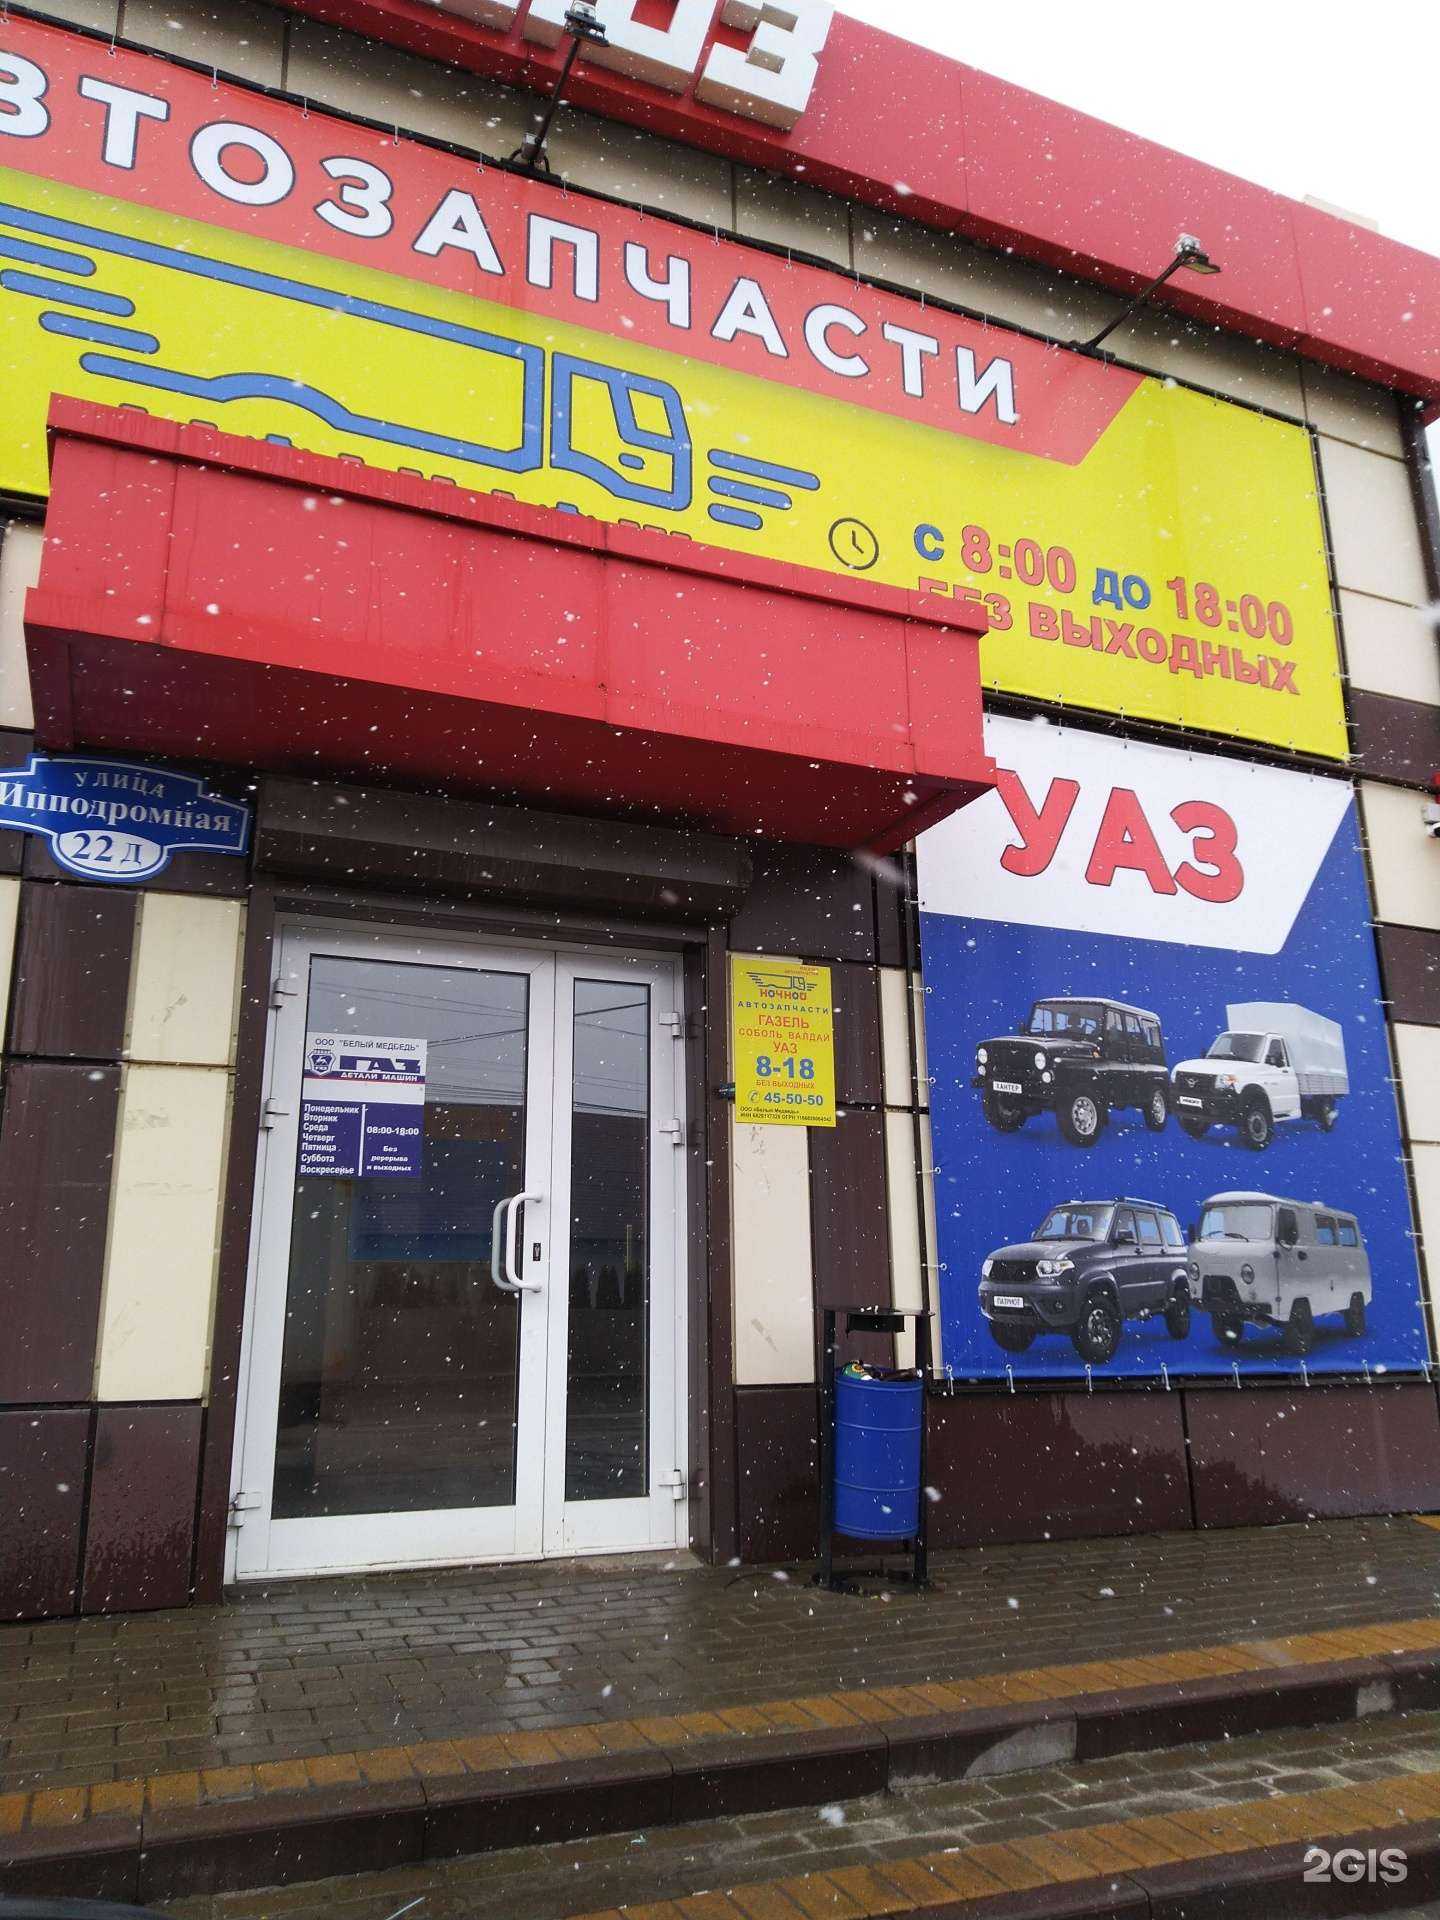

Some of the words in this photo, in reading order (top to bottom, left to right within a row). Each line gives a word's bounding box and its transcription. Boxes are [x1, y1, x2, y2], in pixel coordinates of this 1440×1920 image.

[960, 525, 1077, 593] 8:00
[1166, 576, 1294, 646] 18:00
[1028, 601, 1300, 695] ВЫХОДНЫХ
[0, 781, 232, 833] Ипподромная
[995, 767, 1245, 903] УАЗ
[737, 1000, 829, 1014] АВТОЗАПЧАСТИ
[758, 1014, 810, 1029] ГАЗЕЛЬ
[738, 1027, 783, 1039] СОБОЛЬ
[315, 1038, 335, 1046] ООО
[772, 1041, 798, 1054] УАЗ
[339, 1055, 421, 1074] ГАЗ
[756, 1055, 815, 1080] 8-18
[340, 1071, 378, 1080] ДЕТАЛИ
[382, 1073, 418, 1082] МАШИН
[772, 1080, 816, 1089] ВЫХОДНЫХ
[763, 1092, 824, 1106] 45-50-50
[304, 1104, 360, 1114] Понедельник
[303, 1113, 338, 1123] Вторник
[303, 1122, 329, 1132] Среда
[366, 1126, 420, 1136] 08:00-18:00
[302, 1132, 336, 1143] Четверг
[301, 1142, 337, 1152] Пятница
[301, 1153, 335, 1164] Суббота
[300, 1164, 355, 1176] Воскресенье
